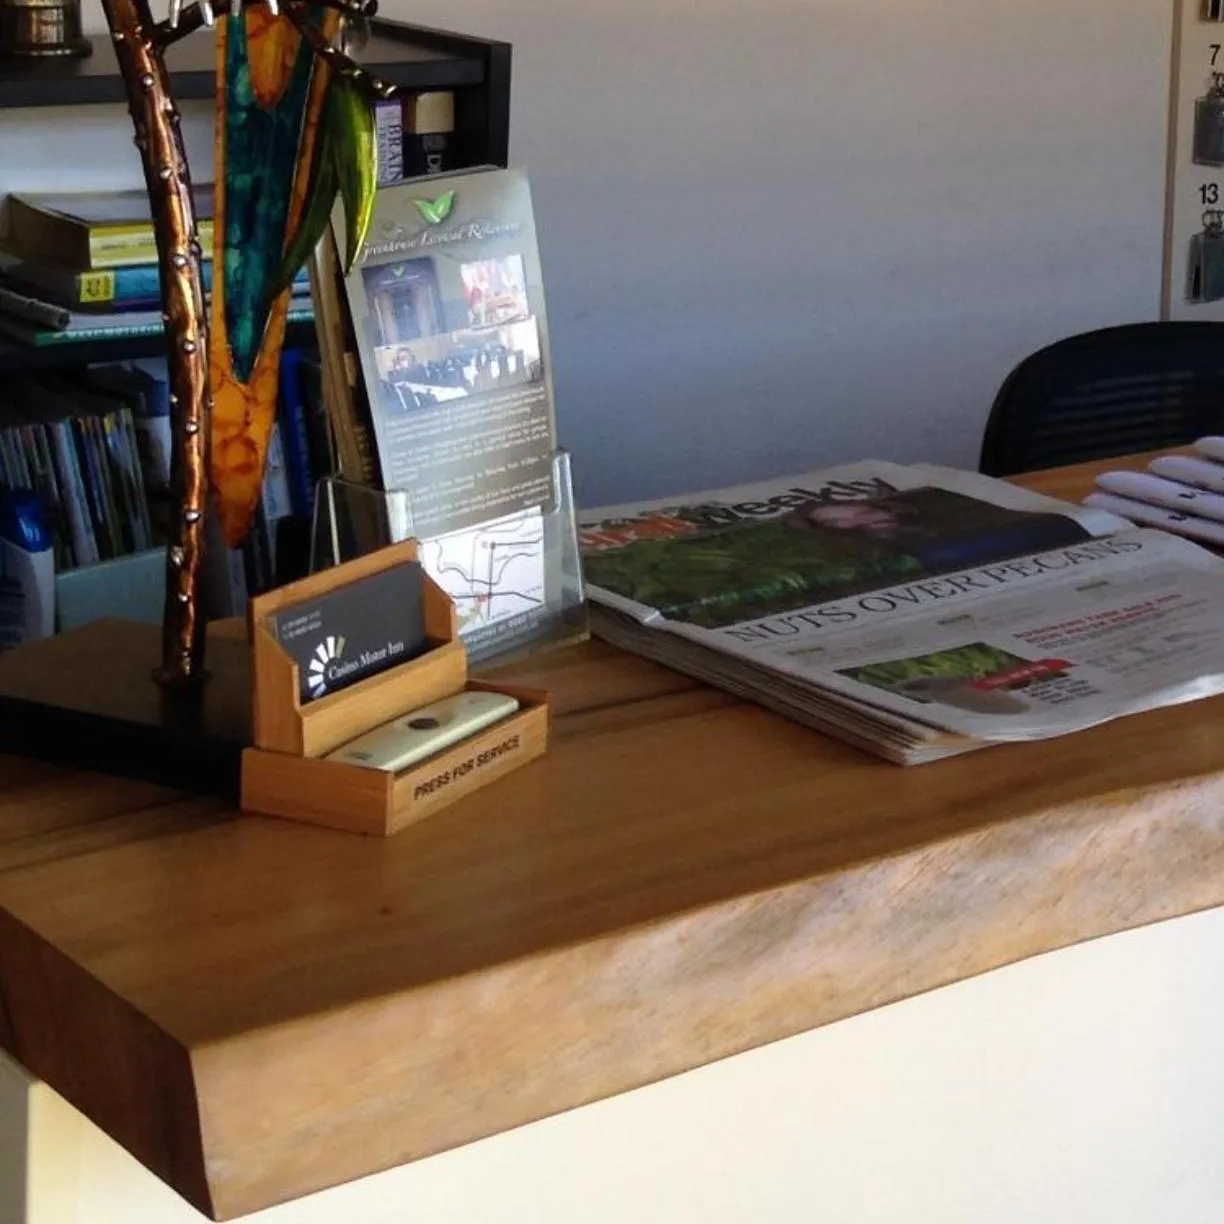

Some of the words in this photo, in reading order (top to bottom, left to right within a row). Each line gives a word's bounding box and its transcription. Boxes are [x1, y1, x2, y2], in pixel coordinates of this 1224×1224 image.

[1209, 43, 1221, 66] 7
[1199, 182, 1219, 205] 13
[725, 606, 857, 643] NUTS
[859, 574, 990, 613] OVER
[984, 538, 1143, 589] PECANS
[360, 649, 387, 668] Motor
[413, 771, 450, 801] PRESS
[452, 758, 475, 781] FOR
[476, 734, 520, 768] SERVICE
